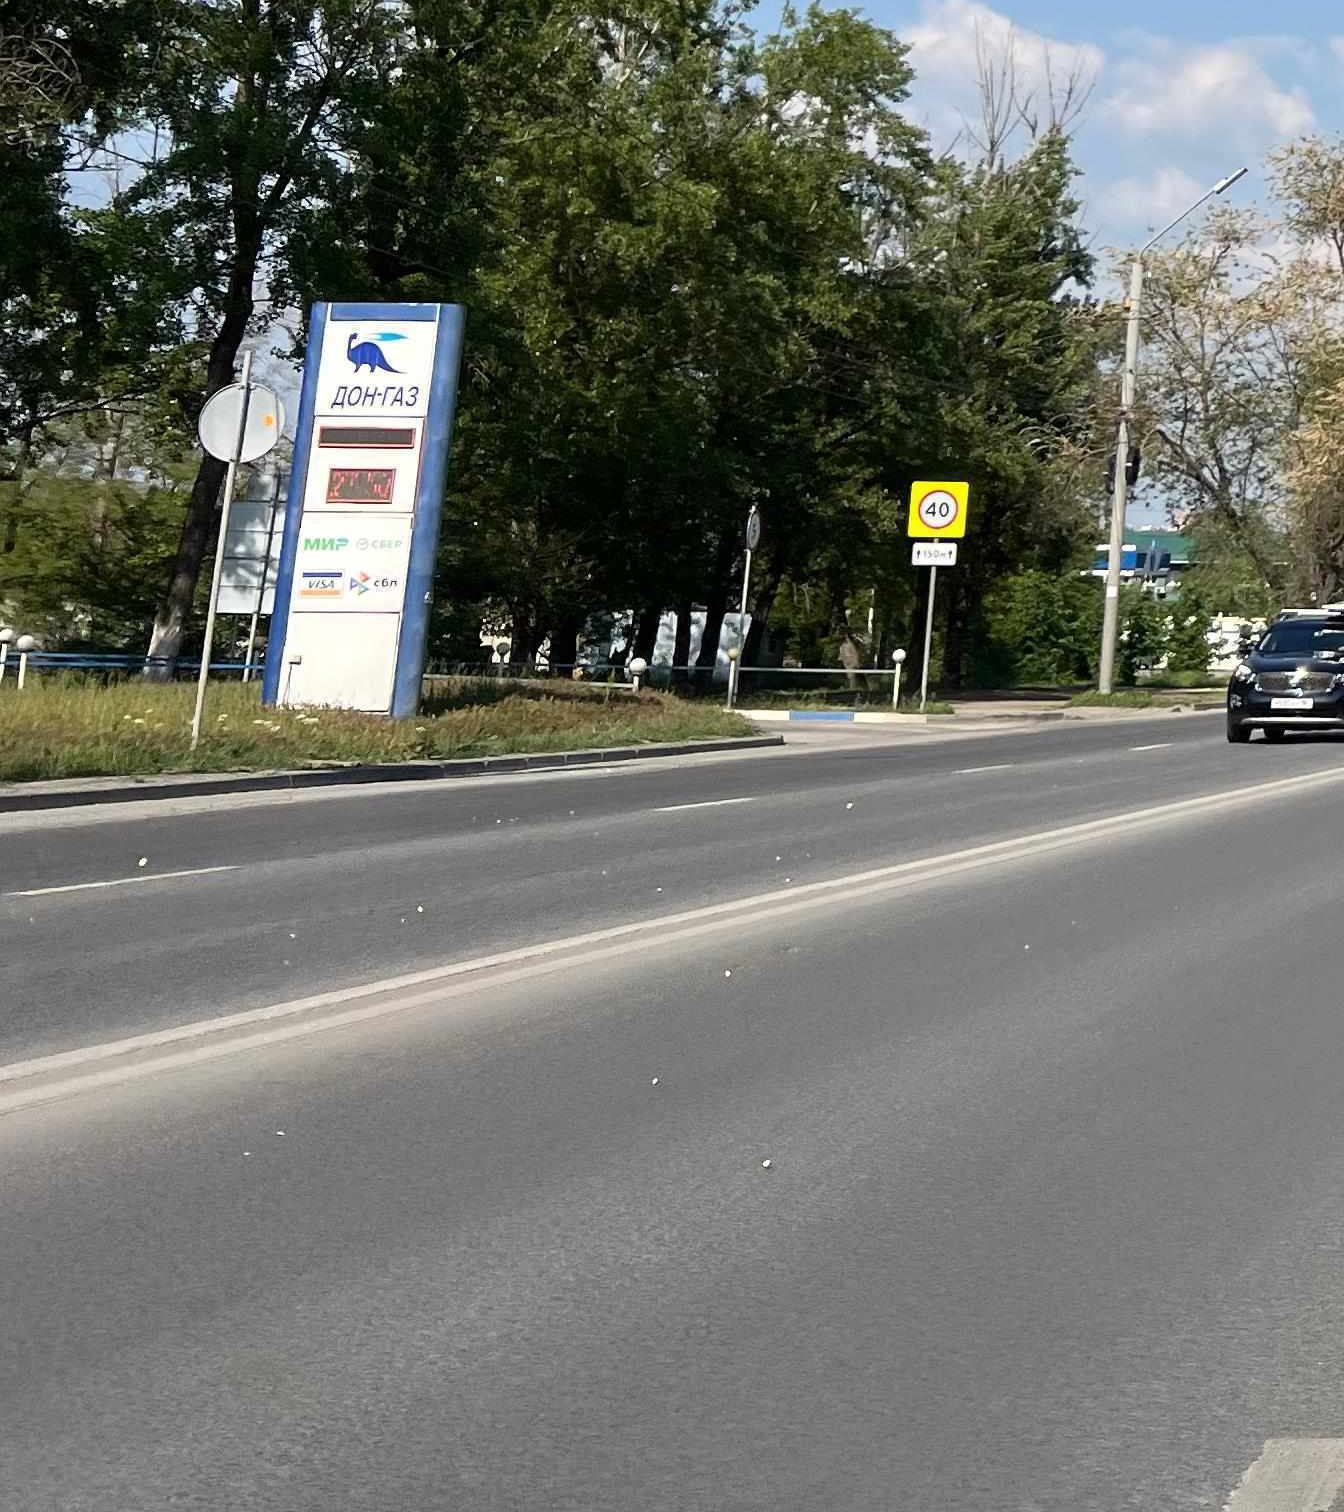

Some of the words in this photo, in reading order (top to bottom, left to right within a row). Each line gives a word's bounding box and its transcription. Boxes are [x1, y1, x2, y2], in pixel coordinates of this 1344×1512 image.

[330, 385, 420, 409] ДОН-ГАЗ
[925, 502, 950, 517] 40
[303, 537, 350, 551] МИР
[308, 579, 336, 589] VISA
